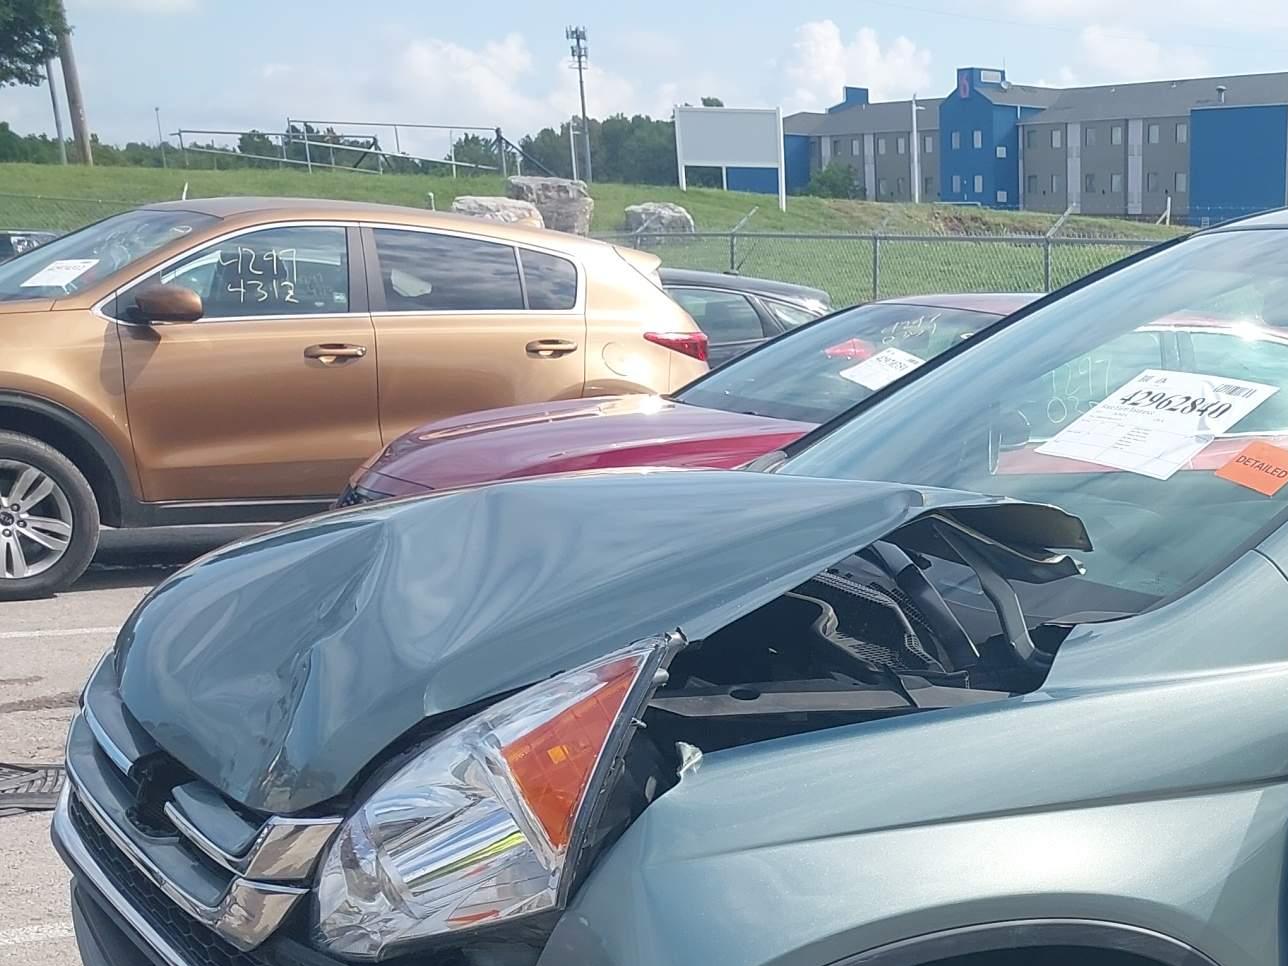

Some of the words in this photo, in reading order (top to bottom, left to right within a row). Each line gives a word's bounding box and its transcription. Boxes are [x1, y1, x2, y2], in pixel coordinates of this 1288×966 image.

[227, 279, 299, 303] 4312
[1119, 389, 1232, 419] 42962840
[1235, 455, 1288, 479] DETAILED
